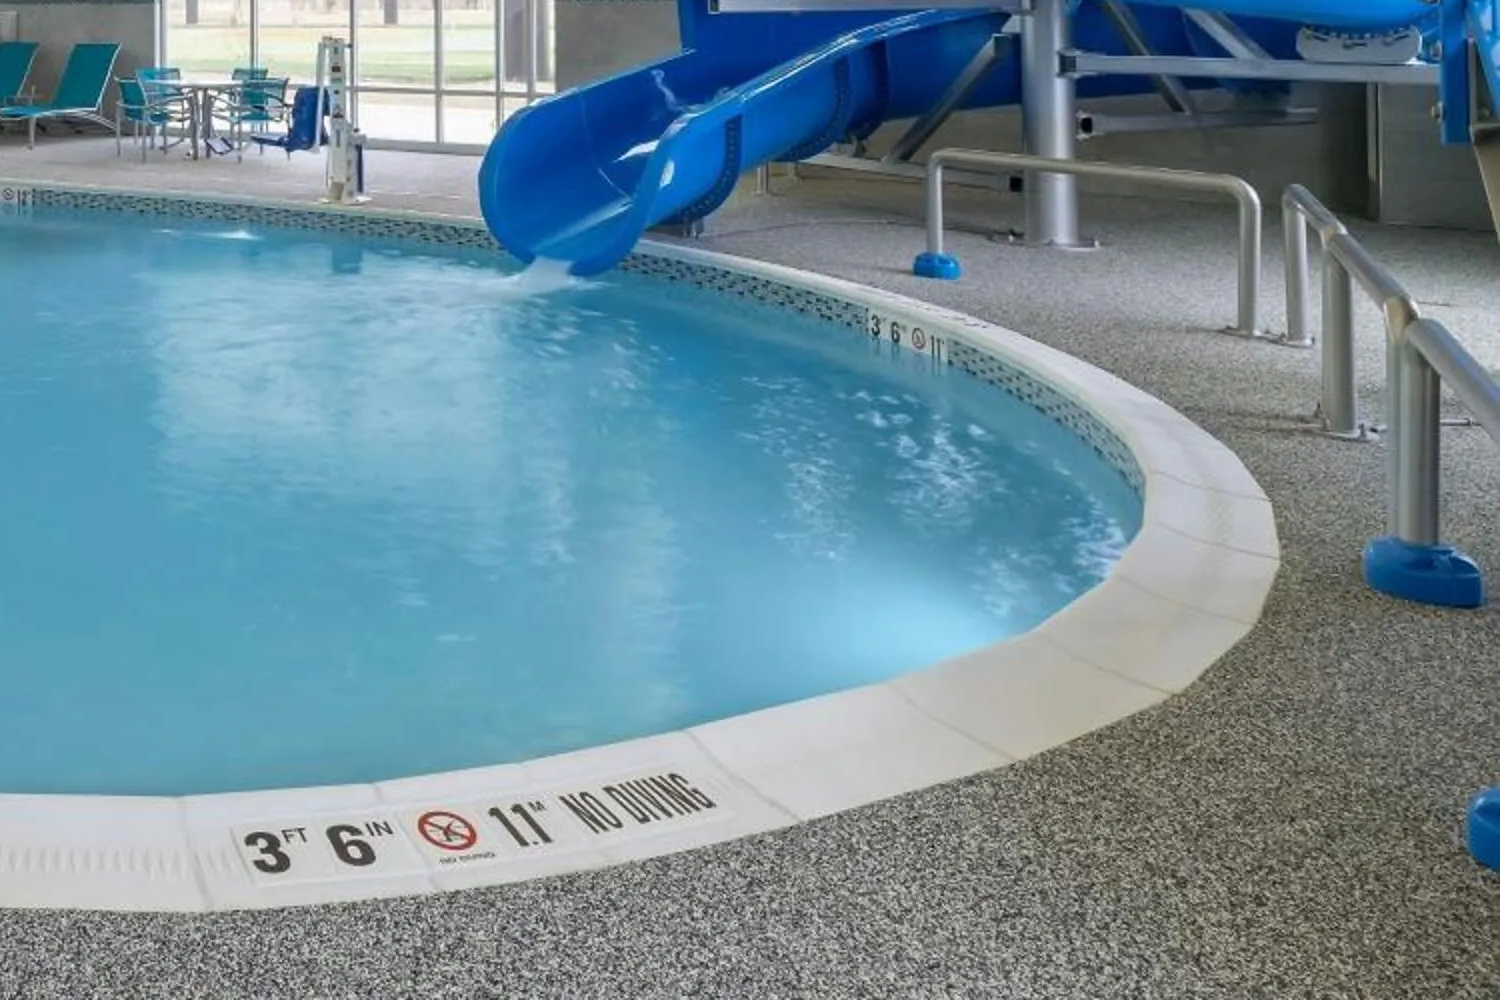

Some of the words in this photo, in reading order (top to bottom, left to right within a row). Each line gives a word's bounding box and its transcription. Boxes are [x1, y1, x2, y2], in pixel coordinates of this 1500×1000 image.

[871, 314, 881, 336] 3
[891, 321, 901, 343] 6
[558, 791, 624, 835] NO
[602, 773, 717, 825] DIVING
